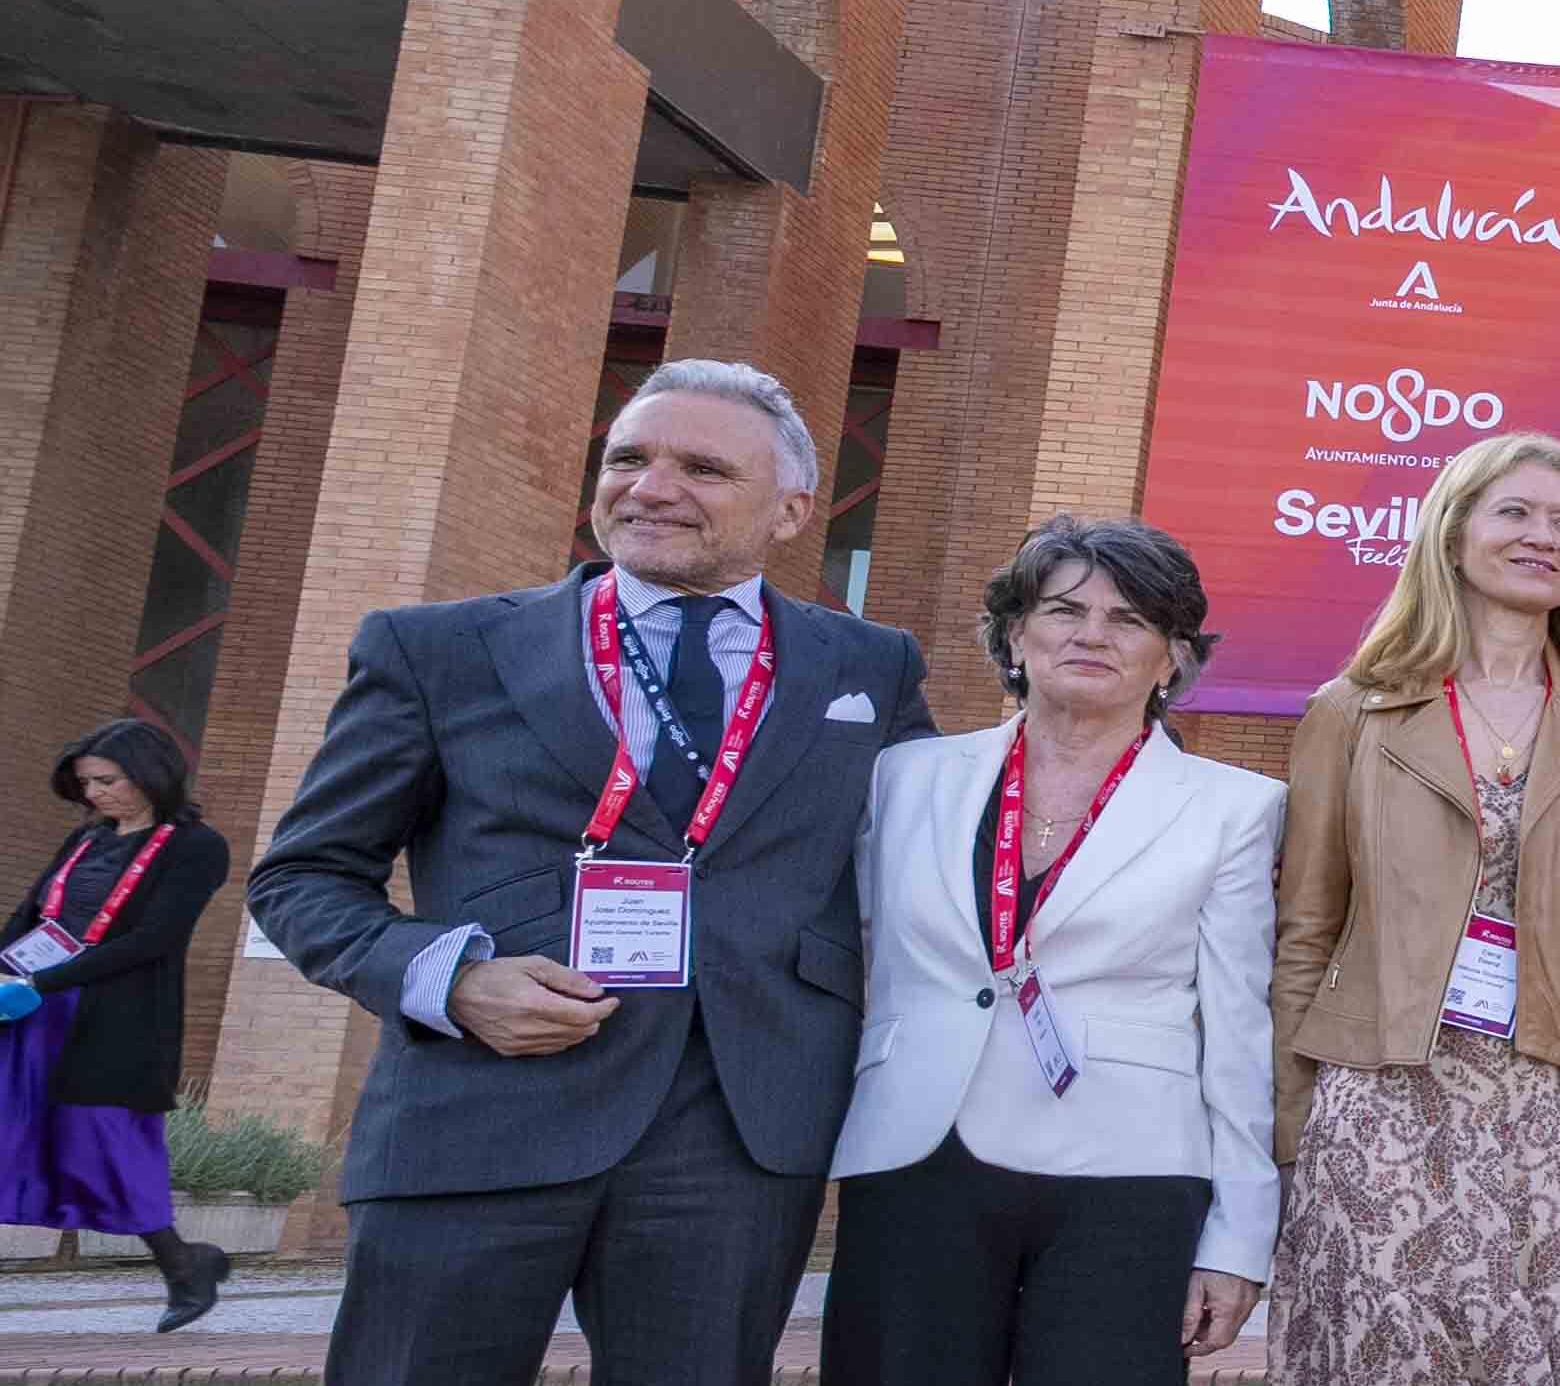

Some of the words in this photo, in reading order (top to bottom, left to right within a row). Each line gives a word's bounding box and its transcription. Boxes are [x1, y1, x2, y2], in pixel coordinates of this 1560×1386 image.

[1369, 297, 1398, 309] Junta
[1400, 300, 1412, 310] de
[1304, 447, 1418, 468] AYUNTAMIENTO
[1421, 456, 1441, 468] DE
[1274, 489, 1419, 542] Sevil
[748, 681, 761, 710] ROUTES
[705, 782, 725, 814] ROUTES
